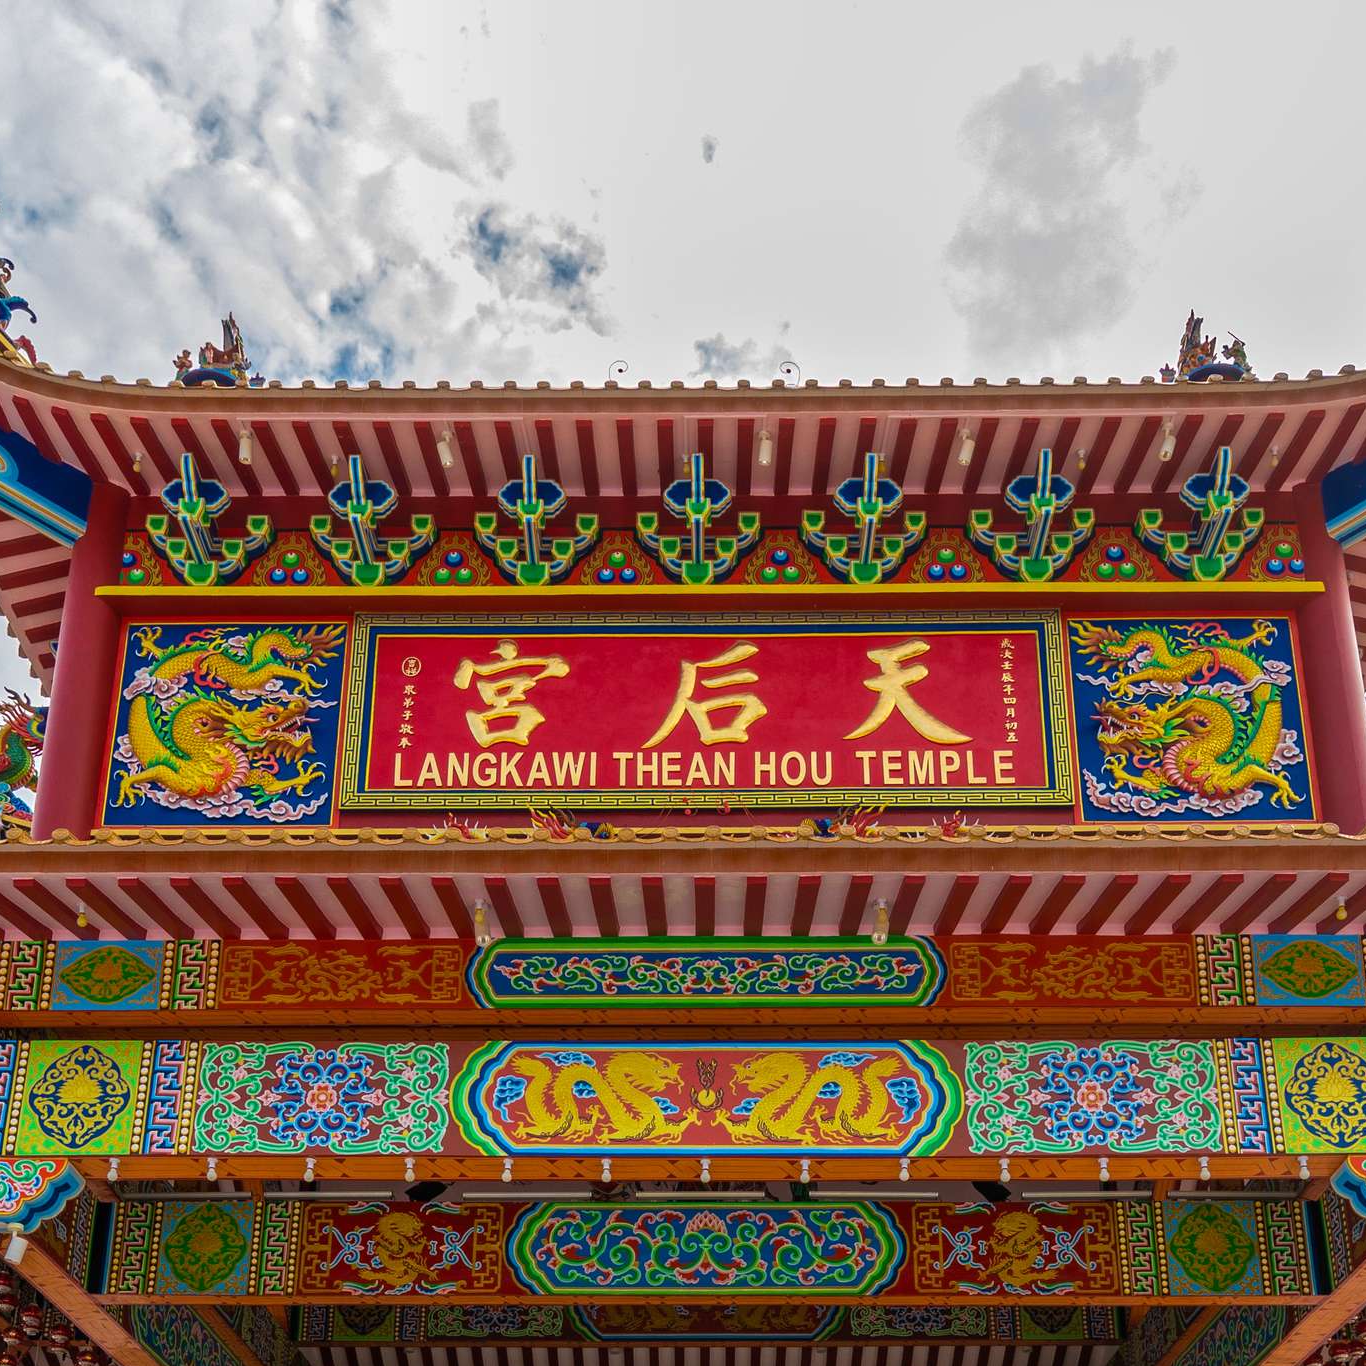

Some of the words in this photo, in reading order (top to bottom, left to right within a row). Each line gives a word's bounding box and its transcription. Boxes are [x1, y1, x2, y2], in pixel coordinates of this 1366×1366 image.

[393, 751, 597, 787] LANGKAWI
[612, 751, 736, 787] THEAN
[754, 750, 833, 786] HOU
[855, 749, 1016, 785] TEMPLE
